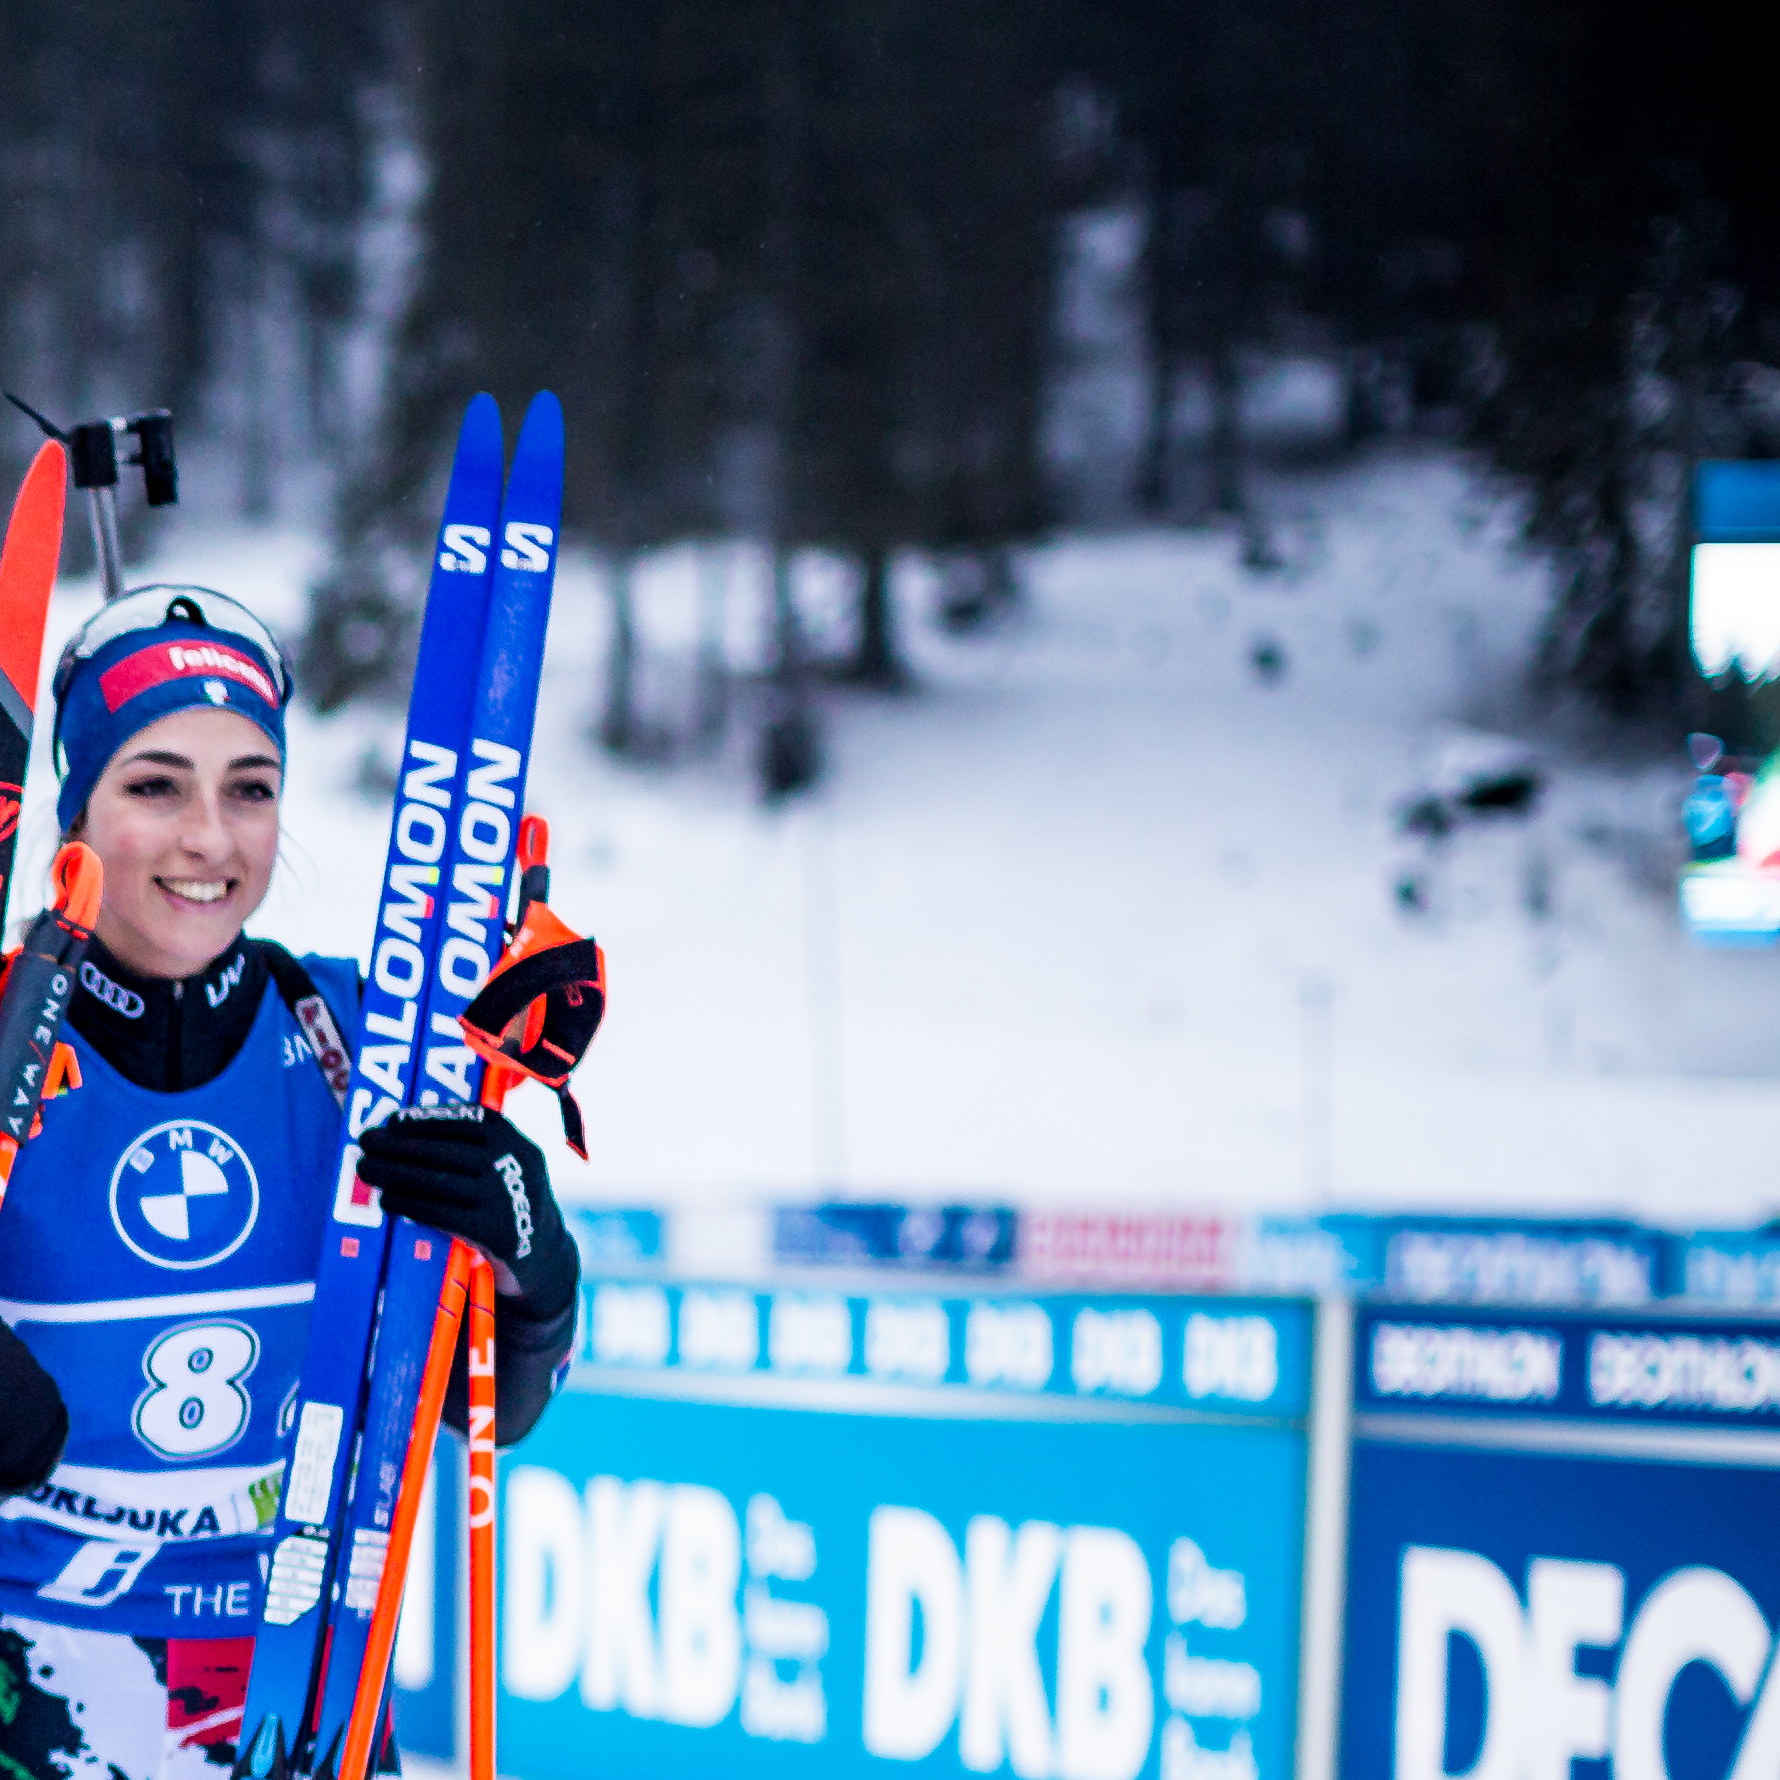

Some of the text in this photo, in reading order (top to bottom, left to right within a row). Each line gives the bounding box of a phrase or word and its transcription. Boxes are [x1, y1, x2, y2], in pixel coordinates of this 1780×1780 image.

[349, 740, 458, 1145] SALOMON
[418, 738, 522, 1107] ALOMON
[133, 1319, 260, 1460] 8
[164, 1581, 251, 1617] THE
[503, 1465, 742, 1729] DKB
